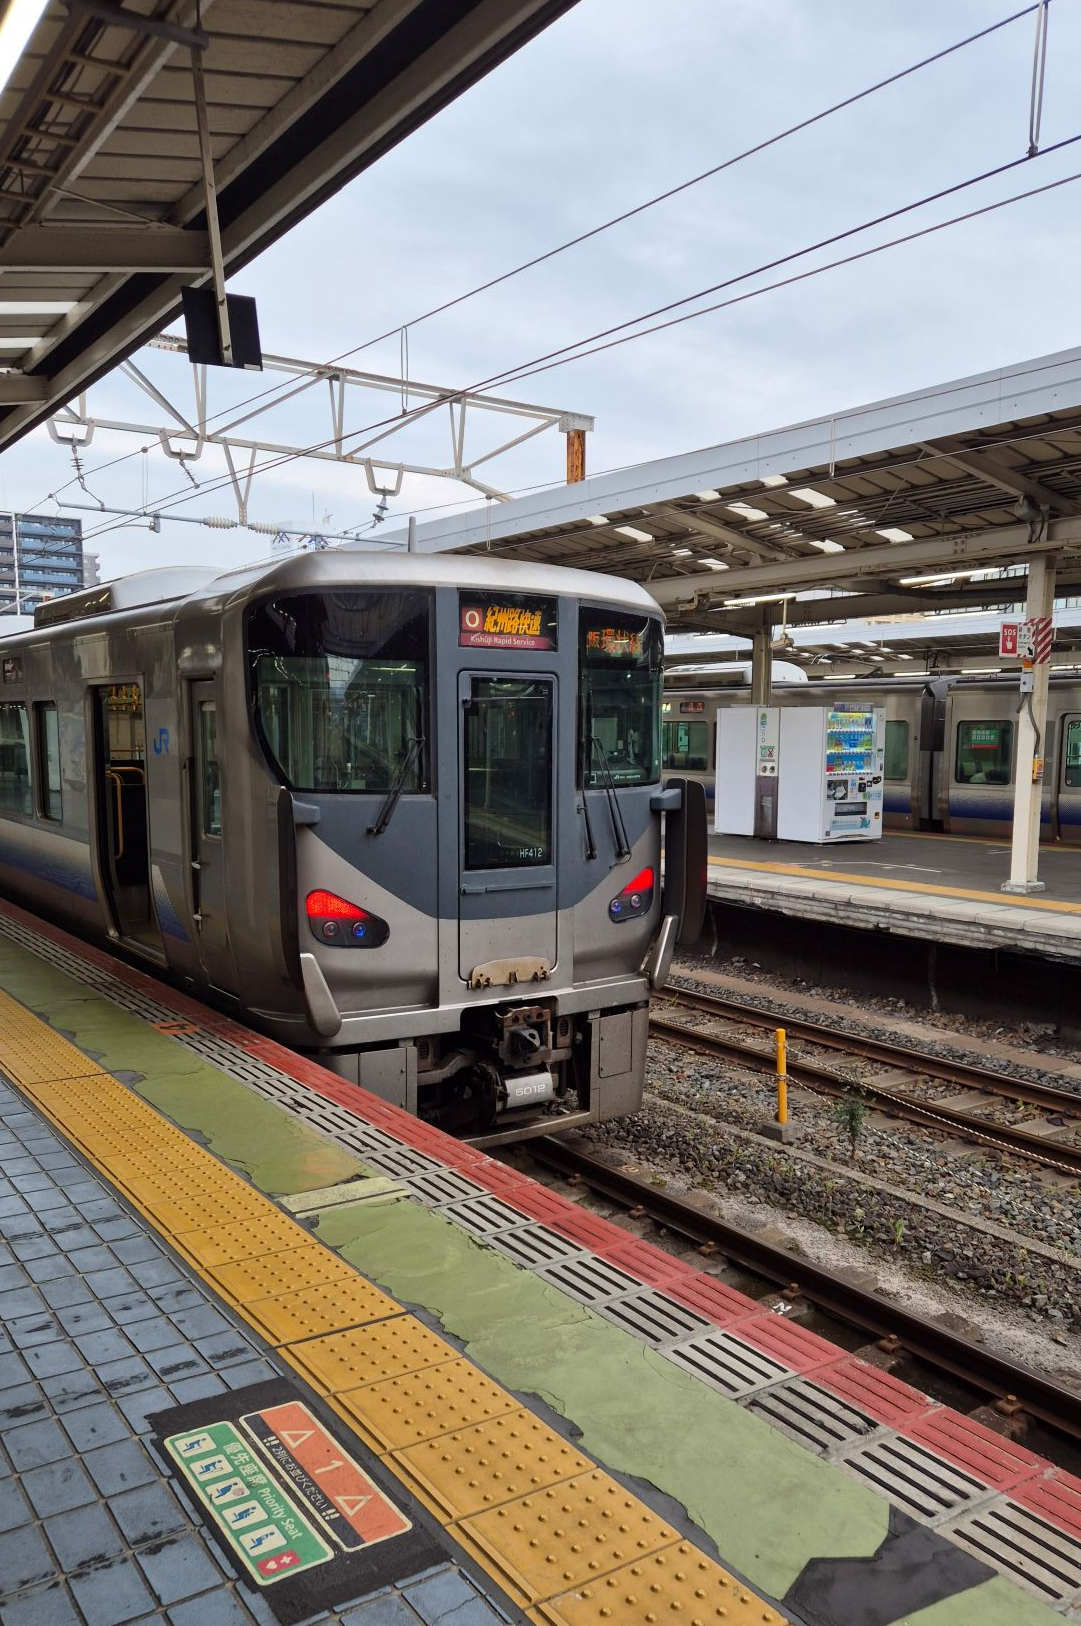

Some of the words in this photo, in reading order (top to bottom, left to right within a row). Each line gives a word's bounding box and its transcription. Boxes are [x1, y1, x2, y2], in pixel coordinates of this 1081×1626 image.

[465, 610, 480, 628] O
[484, 606, 542, 635] 紀州路快速
[494, 636, 512, 647] Rapid
[513, 637, 536, 647] Service
[1003, 628, 1017, 636] SOS
[153, 727, 169, 755] JR
[519, 847, 543, 858] HF412
[271, 1446, 328, 1509] 2列にお並びください
[223, 1442, 268, 1487] 優先座席
[258, 1487, 288, 1519] Priority
[281, 1518, 303, 1540] Seat
